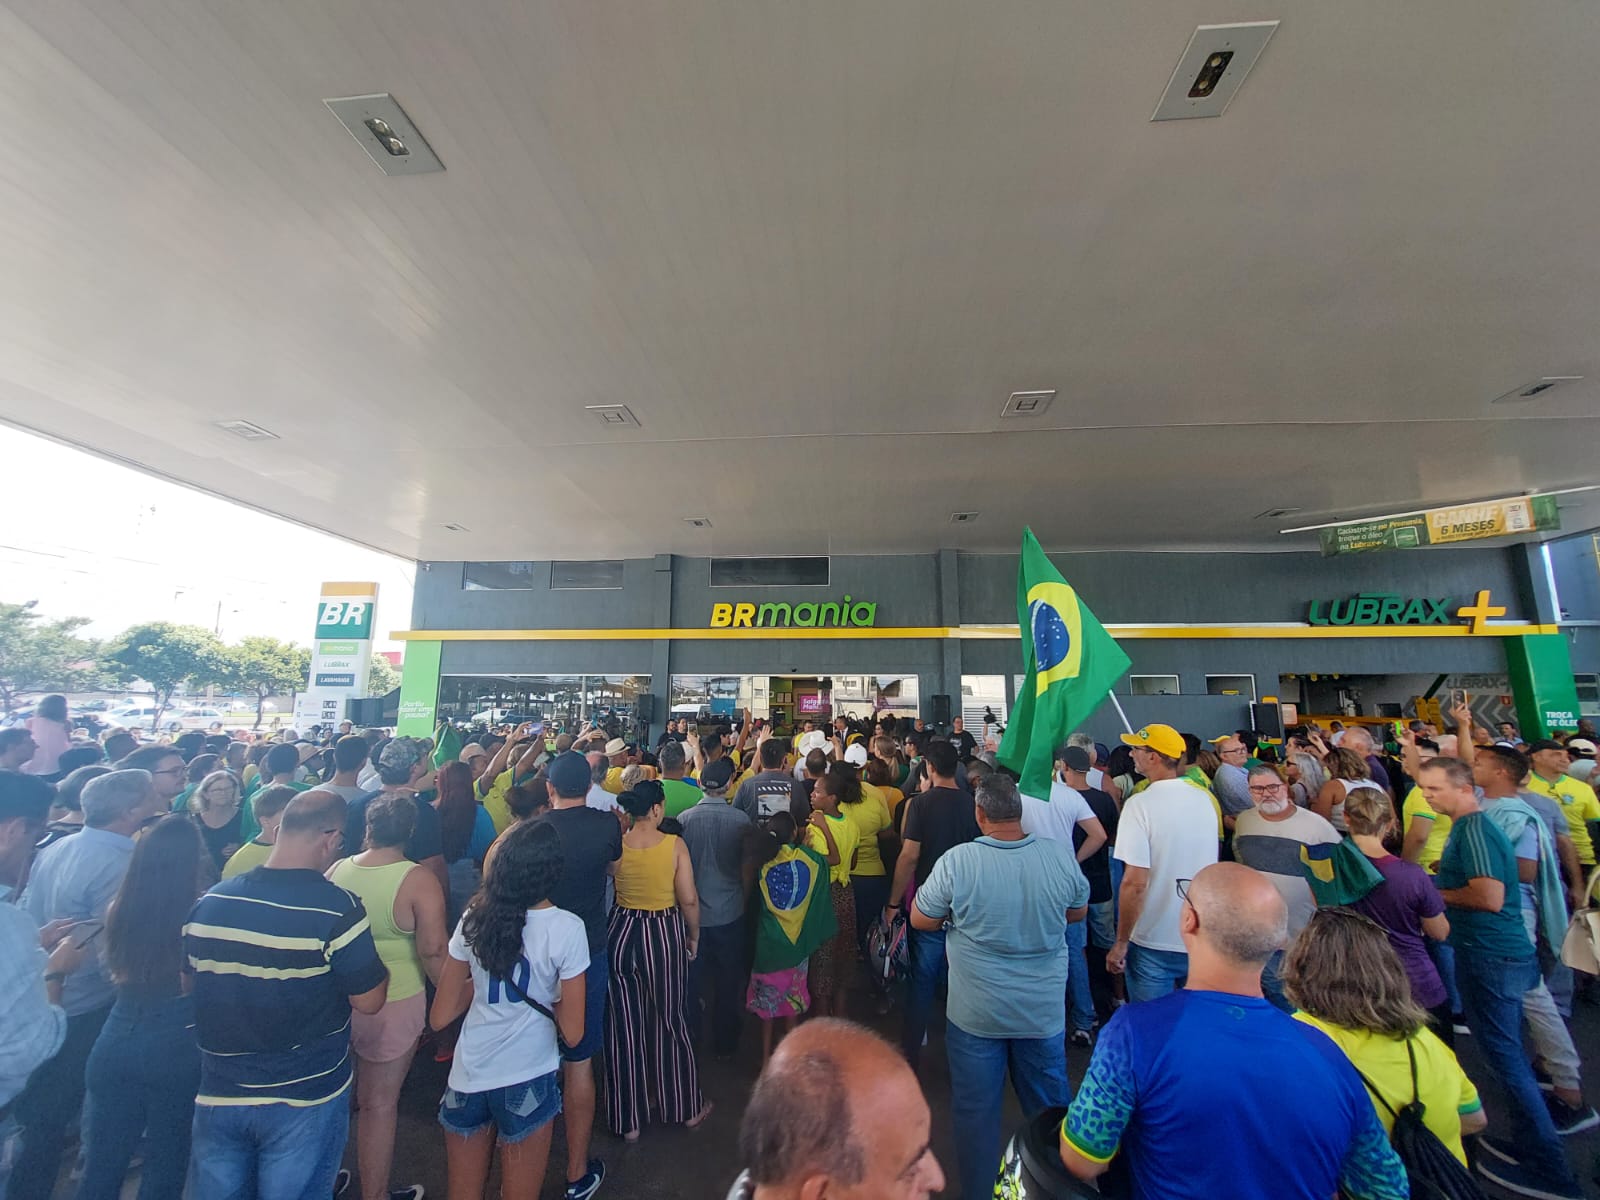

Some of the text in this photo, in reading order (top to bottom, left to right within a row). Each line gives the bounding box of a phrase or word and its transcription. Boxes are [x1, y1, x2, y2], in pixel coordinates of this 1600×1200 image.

[1432, 504, 1498, 528] GANHE
[1441, 525, 1449, 535] 6
[1452, 520, 1496, 533] MESES
[319, 602, 365, 625] BR
[710, 595, 877, 627] BRmania
[1546, 711, 1573, 719] TROCA
[1547, 719, 1560, 727] DE
